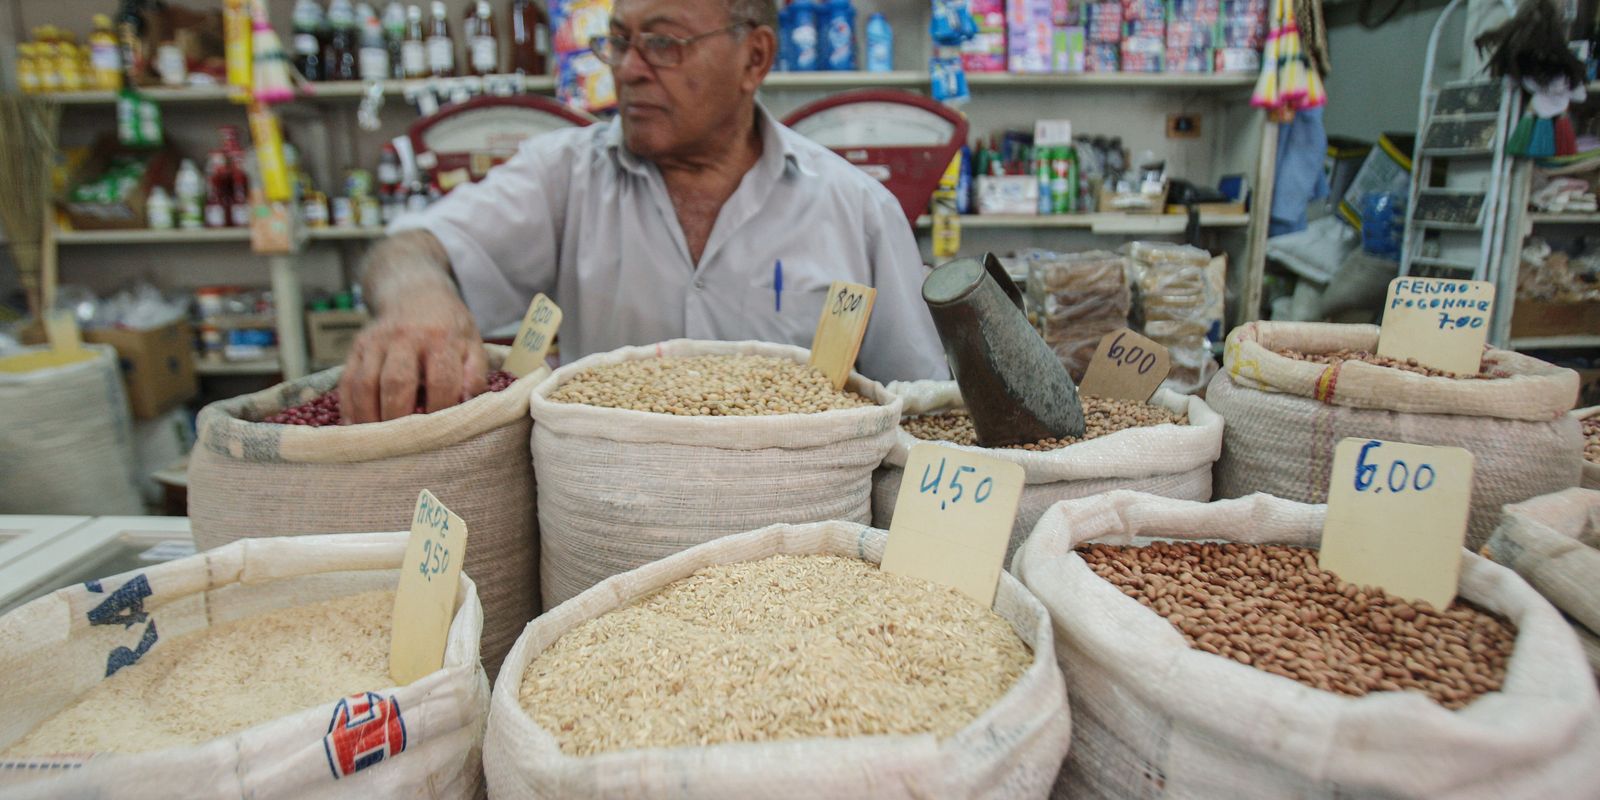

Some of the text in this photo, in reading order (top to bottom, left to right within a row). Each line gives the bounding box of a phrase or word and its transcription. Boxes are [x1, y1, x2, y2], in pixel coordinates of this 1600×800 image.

[1107, 332, 1156, 374] 6,00
[919, 457, 993, 510] 4,50
[419, 538, 449, 582] 2,50
